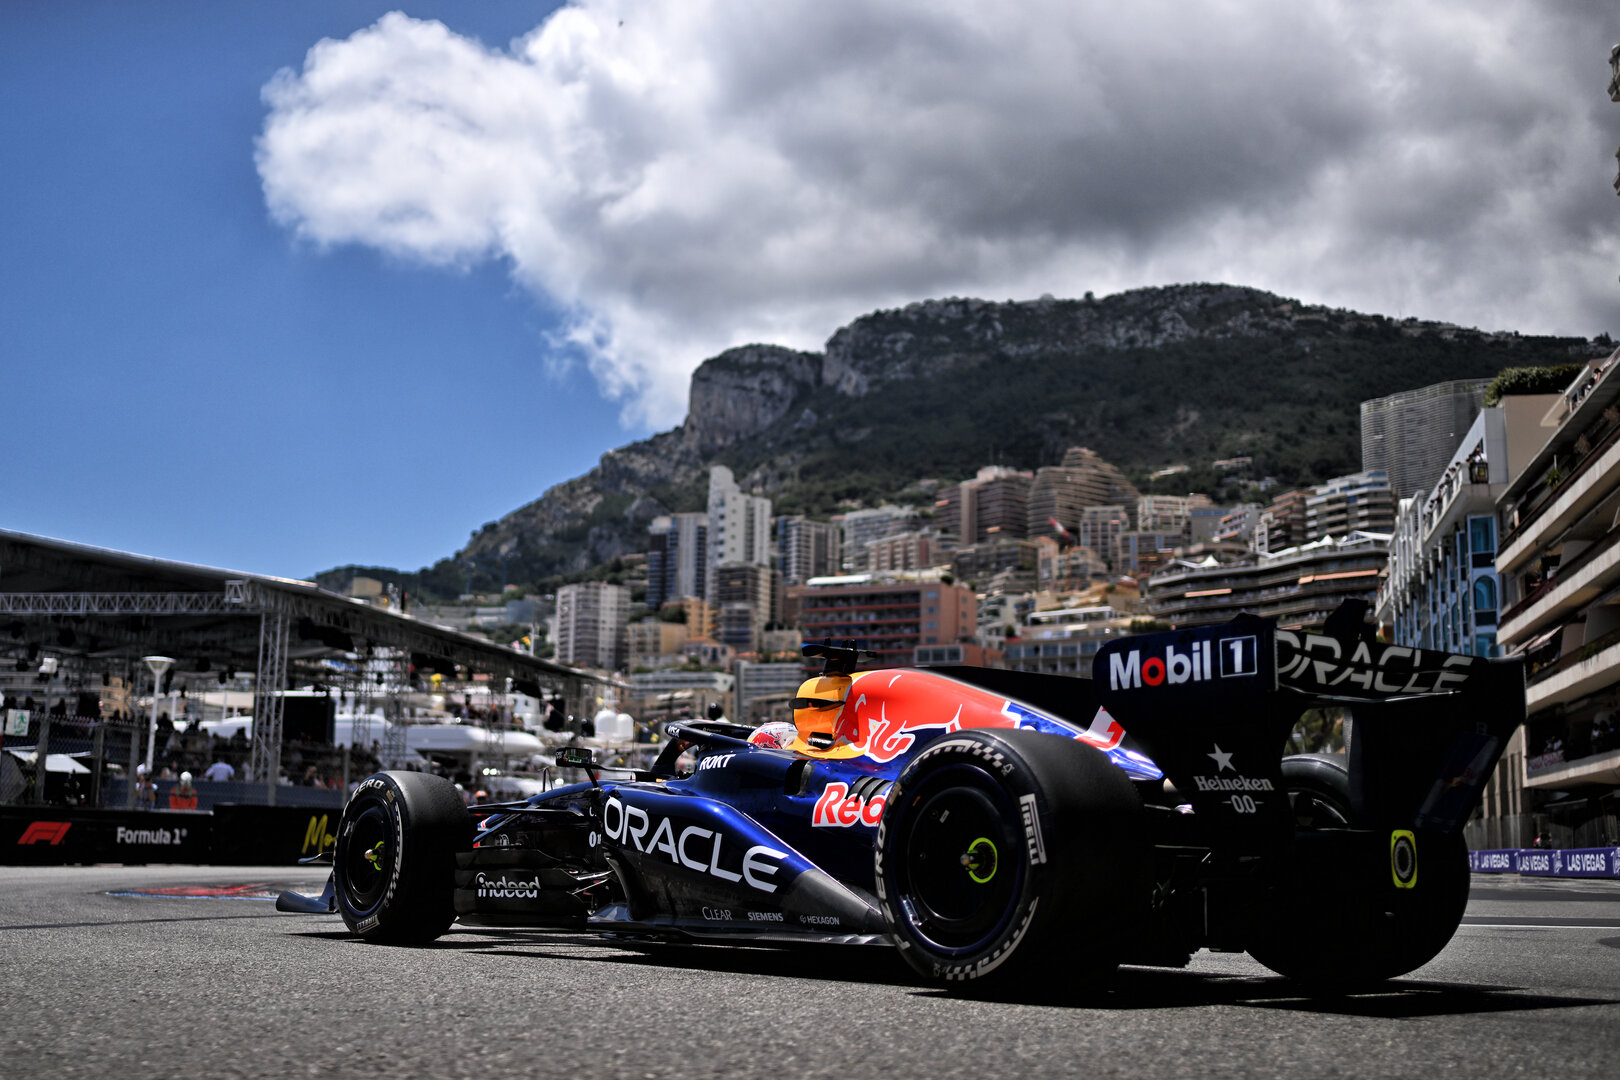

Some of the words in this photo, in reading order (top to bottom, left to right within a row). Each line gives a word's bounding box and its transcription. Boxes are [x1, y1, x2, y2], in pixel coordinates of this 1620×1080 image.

[1109, 640, 1212, 691] Mobil
[1229, 640, 1243, 673] 1
[699, 754, 737, 771] ROKT
[1193, 775, 1275, 791] Heineken
[117, 826, 171, 844] Formula
[1019, 793, 1047, 866] PIRELLI
[604, 796, 790, 893] ORACLE
[1490, 853, 1509, 868] VEGAS
[1519, 855, 1530, 871] LAS
[1530, 854, 1549, 871] VEGAS
[1566, 854, 1580, 871] LAS
[1580, 853, 1606, 871] VEGAS
[476, 872, 541, 898] indeed
[747, 911, 784, 922] SIEMENS
[807, 915, 840, 926] HEXAGON
